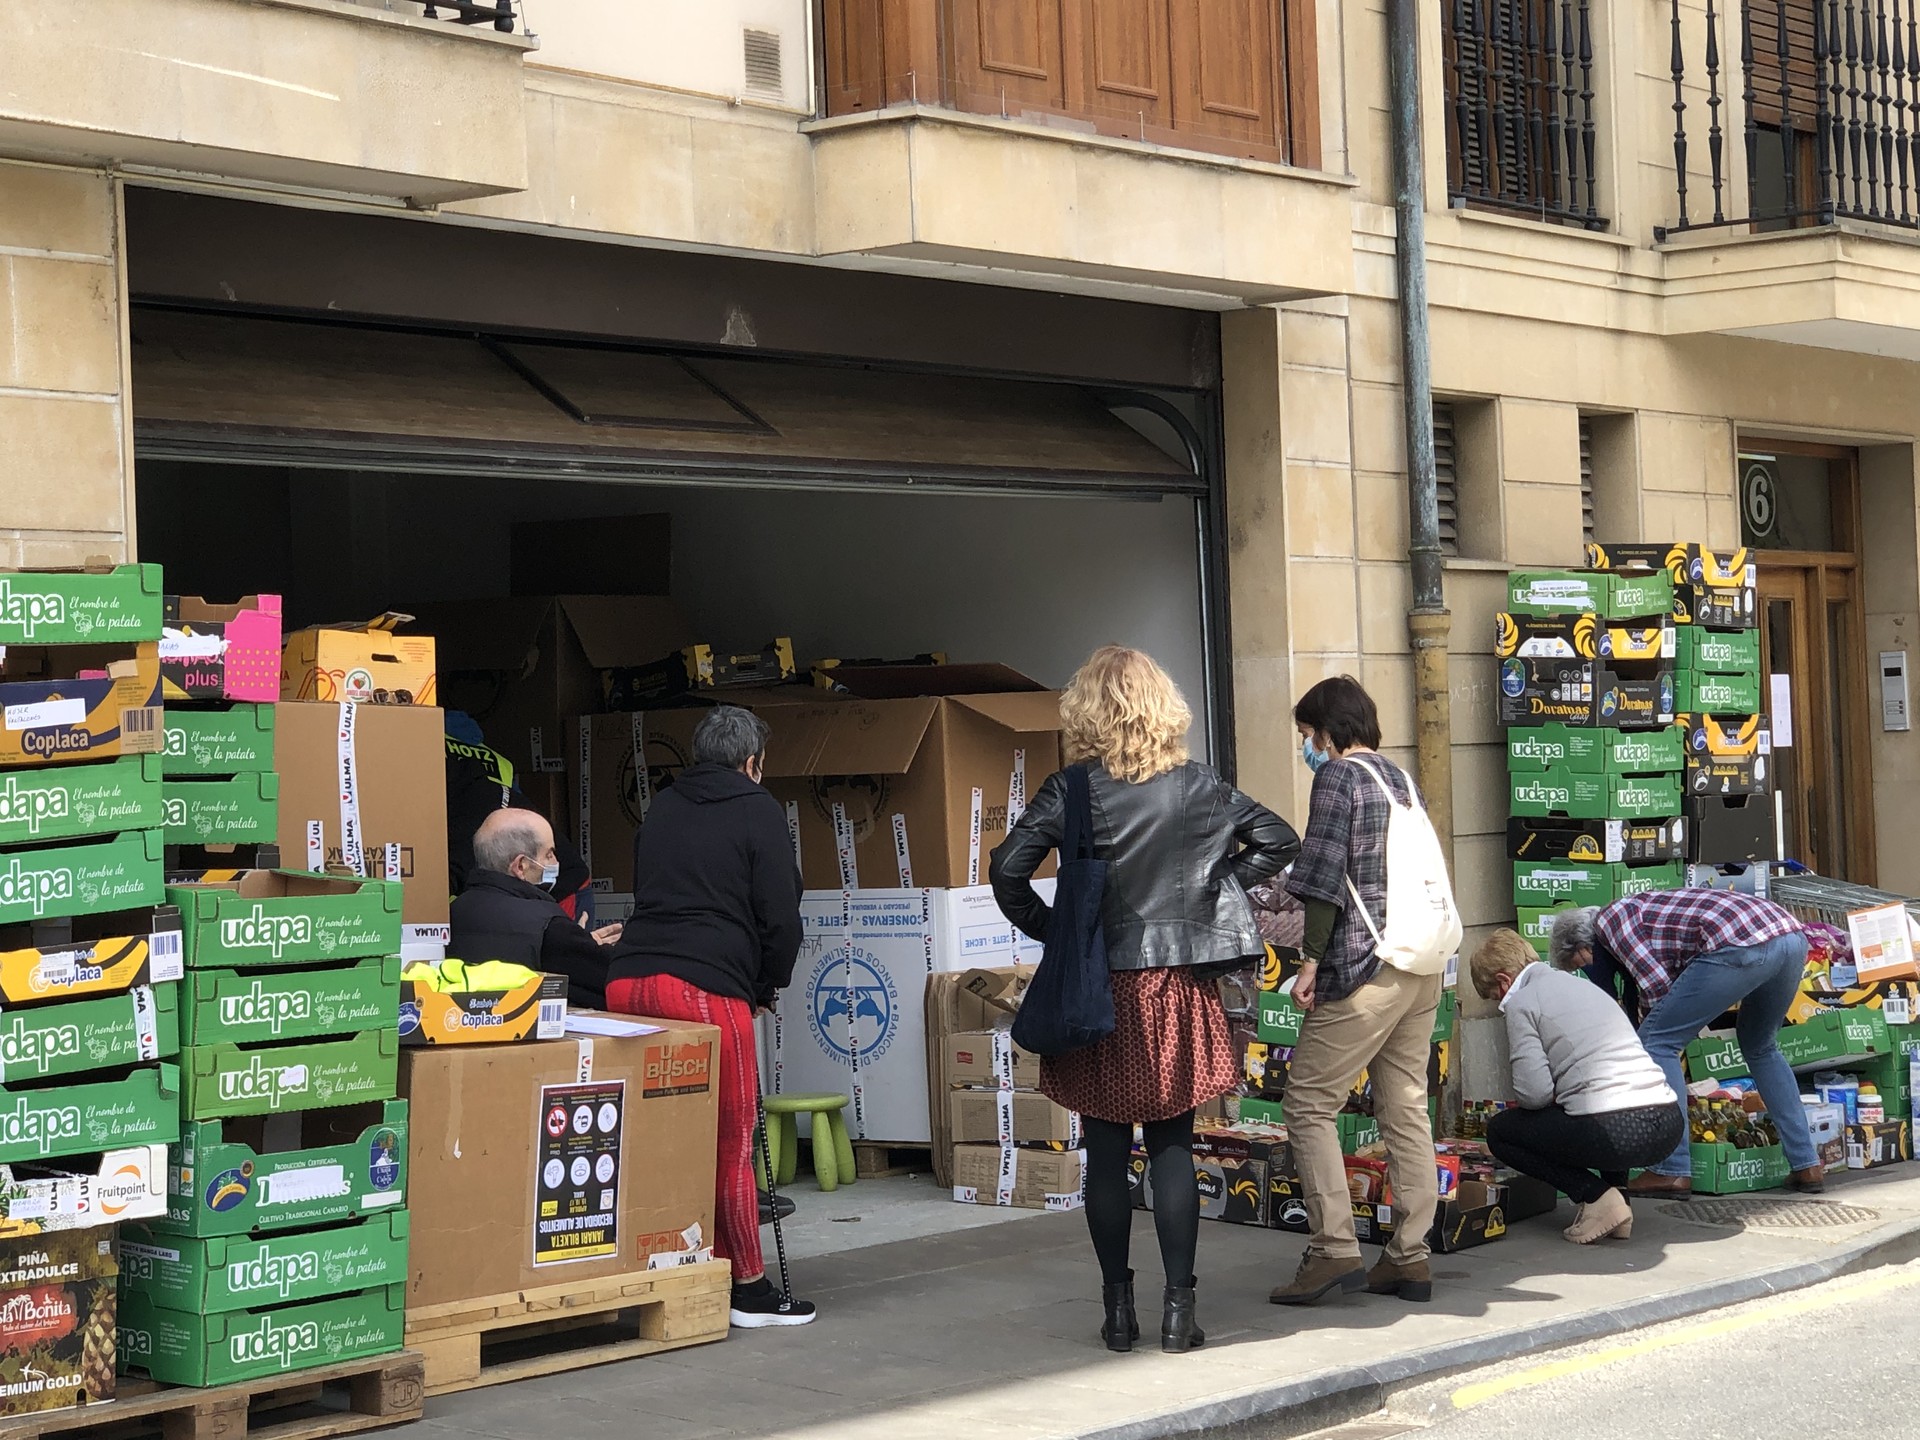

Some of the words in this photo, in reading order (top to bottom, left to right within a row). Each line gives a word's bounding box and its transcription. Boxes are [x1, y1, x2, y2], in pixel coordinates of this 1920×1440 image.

[1750, 475, 1769, 525] 6
[70, 597, 81, 609] El
[82, 598, 108, 609] nombre
[110, 598, 120, 609] de
[1616, 581, 1643, 614] udapa
[95, 613, 107, 627] la
[108, 613, 142, 629] patata
[1701, 636, 1731, 669] udapa
[185, 670, 219, 690] plus
[1620, 693, 1653, 711] Doramas
[1700, 678, 1731, 710] udapa
[1531, 698, 1590, 715] Doramas
[24, 728, 89, 754] Coplaca
[191, 731, 200, 743] El
[201, 731, 226, 743] nombre
[228, 731, 237, 743] de
[214, 747, 223, 760] la
[225, 748, 256, 760] patata
[446, 740, 494, 762] HOTZ
[1511, 737, 1564, 764] udapa
[1613, 737, 1650, 769] udapa
[72, 789, 83, 801] El
[84, 788, 110, 799] nombre
[112, 787, 122, 798] de
[1515, 781, 1569, 809] udapa
[1617, 781, 1650, 814] udapa
[98, 802, 108, 817] la
[110, 802, 142, 818] patata
[191, 801, 200, 813] El
[201, 801, 227, 813] nombre
[228, 801, 238, 813] de
[215, 816, 224, 829] la
[226, 816, 258, 830] patata
[835, 811, 843, 837] ULMA
[895, 831, 905, 856] ULMA
[77, 867, 87, 880] El
[88, 866, 113, 878] nombre
[114, 863, 124, 876] de
[842, 859, 850, 885] ULMA
[101, 884, 111, 896] la
[113, 881, 144, 896] patata
[316, 916, 324, 929] El
[325, 916, 352, 928] nombre
[353, 915, 362, 926] de
[862, 914, 922, 927] CONSERVAS
[220, 904, 311, 957] udapa
[338, 930, 348, 945] la
[350, 931, 382, 947] patata
[414, 927, 439, 936] ULMA
[965, 936, 988, 948] LECHE
[805, 946, 846, 999] ALIMENTOS
[865, 952, 898, 999] BANCOS
[315, 992, 324, 1003] El
[325, 990, 350, 1002] nombre
[352, 988, 361, 1000] de
[220, 981, 310, 1033] udapa
[338, 1005, 348, 1019] la
[349, 1004, 380, 1021] patata
[84, 1024, 93, 1037] El
[94, 1022, 123, 1034] nombre
[125, 1019, 134, 1031] de
[461, 1014, 503, 1029] Coplaca
[871, 1013, 899, 1061] BANCOS
[1845, 1018, 1874, 1047] udapa
[0, 1017, 80, 1073] dapa
[111, 1036, 122, 1050] la
[1795, 1047, 1803, 1057] la
[1804, 1045, 1828, 1057] patata
[313, 1065, 322, 1077] El
[322, 1064, 347, 1075] nombre
[349, 1062, 358, 1073] de
[646, 1058, 708, 1079] BUSCH
[335, 1078, 344, 1092] la
[346, 1078, 376, 1094] patata
[86, 1105, 95, 1118] El
[96, 1103, 123, 1116] nombre
[125, 1101, 136, 1114] de
[1859, 1108, 1882, 1116] nutella
[111, 1119, 121, 1134] la
[123, 1117, 157, 1137] patata
[1002, 1150, 1011, 1176] ULMA
[1728, 1152, 1765, 1187] udapa
[97, 1182, 146, 1199] Fruitpoint
[259, 1214, 284, 1224] CULTIVO
[285, 1209, 322, 1221] TRADICIONAL
[323, 1205, 349, 1216] CANARIO
[575, 1216, 584, 1229] DE
[584, 1213, 613, 1229] RECOGIDA
[539, 1217, 575, 1233] ALIMENTOS
[551, 1233, 580, 1248] BILKETA
[18, 1250, 50, 1267] PIÑA
[323, 1250, 332, 1262] El
[332, 1248, 358, 1261] nombre
[360, 1244, 368, 1256] de
[0, 1263, 79, 1284] XTRADULCE
[228, 1245, 318, 1297] udapa
[345, 1261, 355, 1275] la
[356, 1257, 387, 1275] patata
[25, 1300, 72, 1321] Bonita
[322, 1320, 331, 1333] El
[331, 1317, 356, 1330] nombre
[357, 1314, 367, 1327] de
[231, 1316, 318, 1368] udapa
[345, 1331, 354, 1346] la
[355, 1328, 385, 1347] patata
[46, 1374, 82, 1388] GOLD
